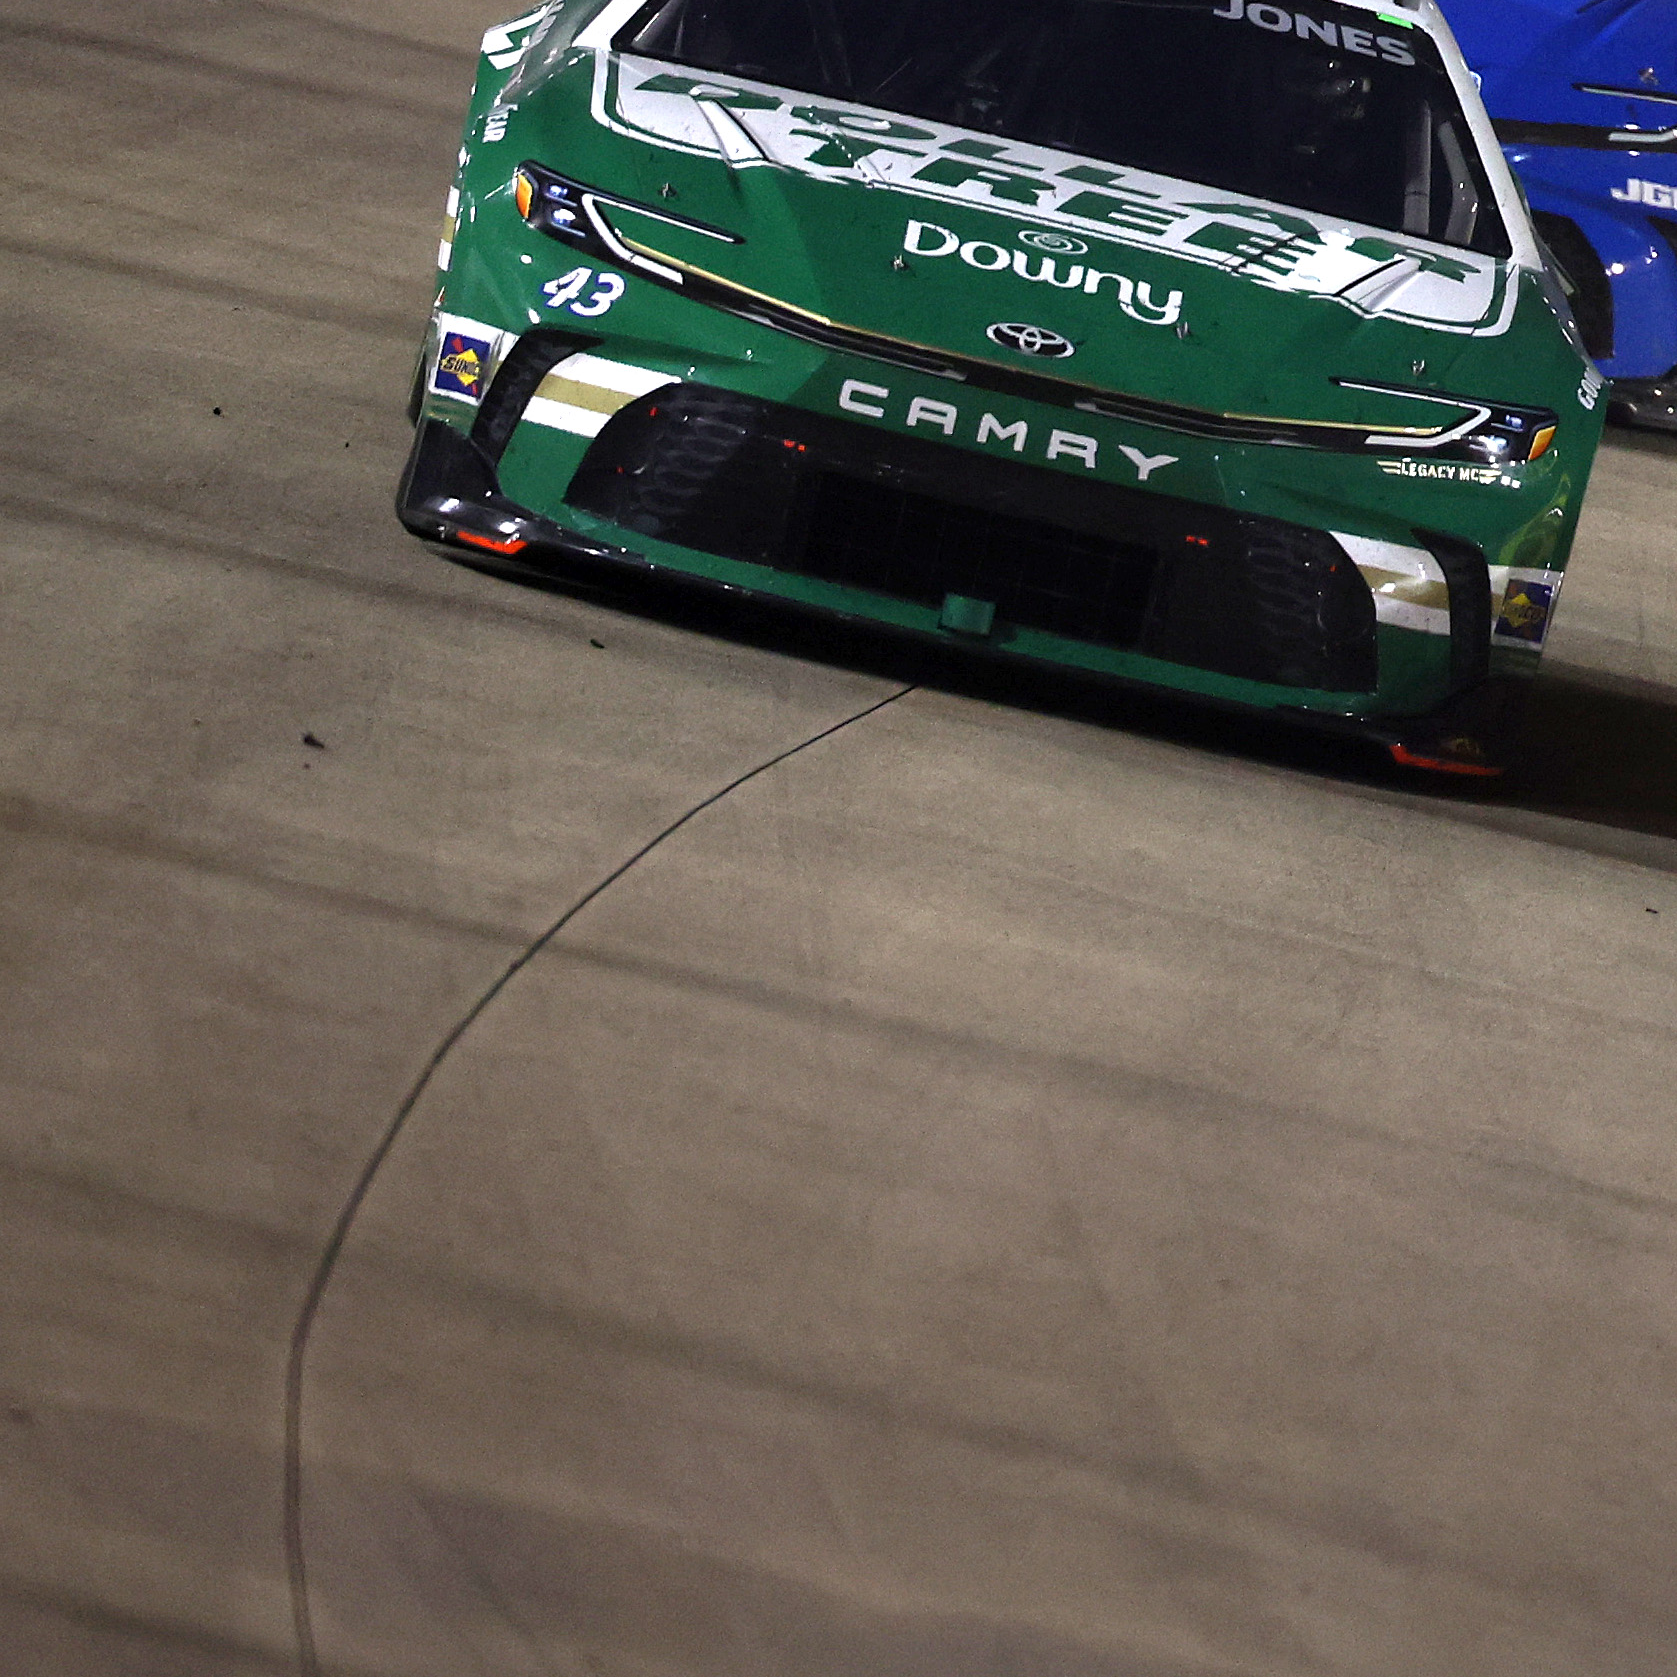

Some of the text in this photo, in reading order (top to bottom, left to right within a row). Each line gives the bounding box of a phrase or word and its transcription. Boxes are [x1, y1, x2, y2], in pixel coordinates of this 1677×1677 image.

[542, 266, 628, 317] 43
[904, 218, 1184, 326] Downy
[838, 379, 1180, 480] CAMRY
[1402, 462, 1455, 479] LEGACY
